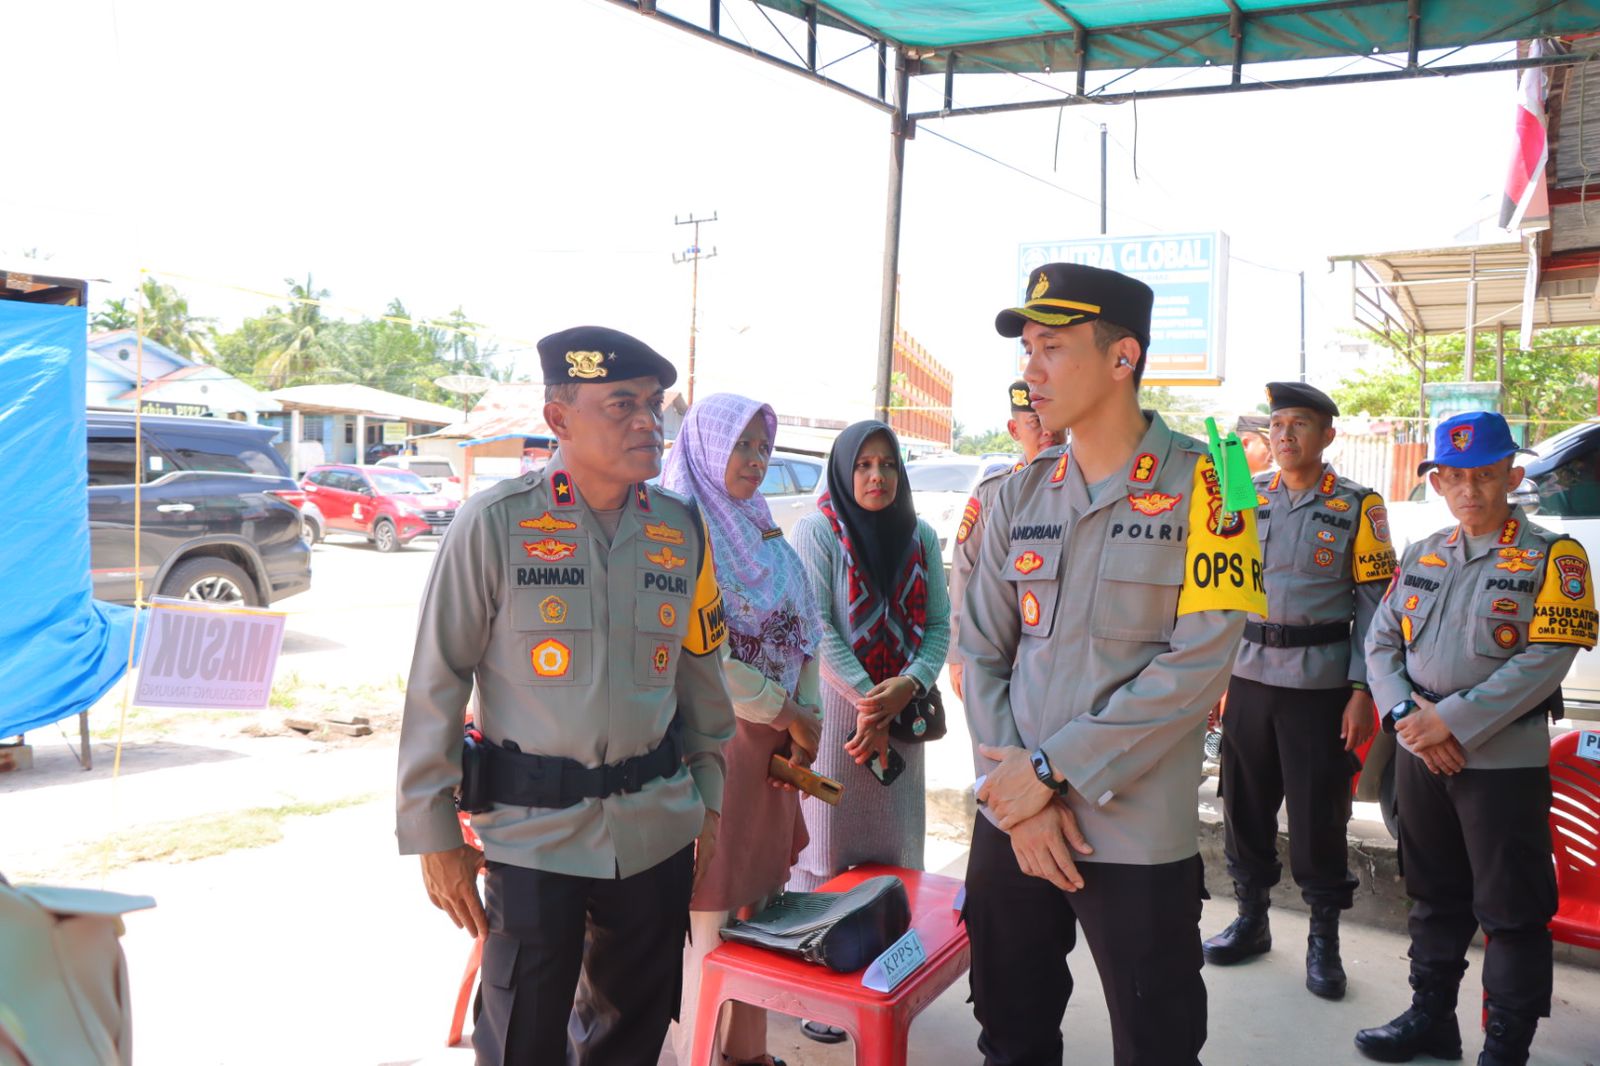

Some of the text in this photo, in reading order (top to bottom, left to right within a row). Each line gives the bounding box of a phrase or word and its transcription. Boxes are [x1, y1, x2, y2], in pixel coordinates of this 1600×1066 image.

[1120, 239, 1209, 271] GLOBAL
[1312, 511, 1352, 530] POLRI
[1011, 524, 1062, 541] ANDRIAN
[1111, 523, 1183, 542] POLRI
[517, 567, 584, 585] RAHMADI
[1193, 552, 1244, 588] OPS
[644, 572, 687, 595] POLRI
[1486, 578, 1535, 593] POLRI
[1538, 626, 1556, 635] OMB
[1559, 627, 1568, 635] LK
[1549, 617, 1593, 631] POLAIR
[884, 941, 914, 975] KPPS
